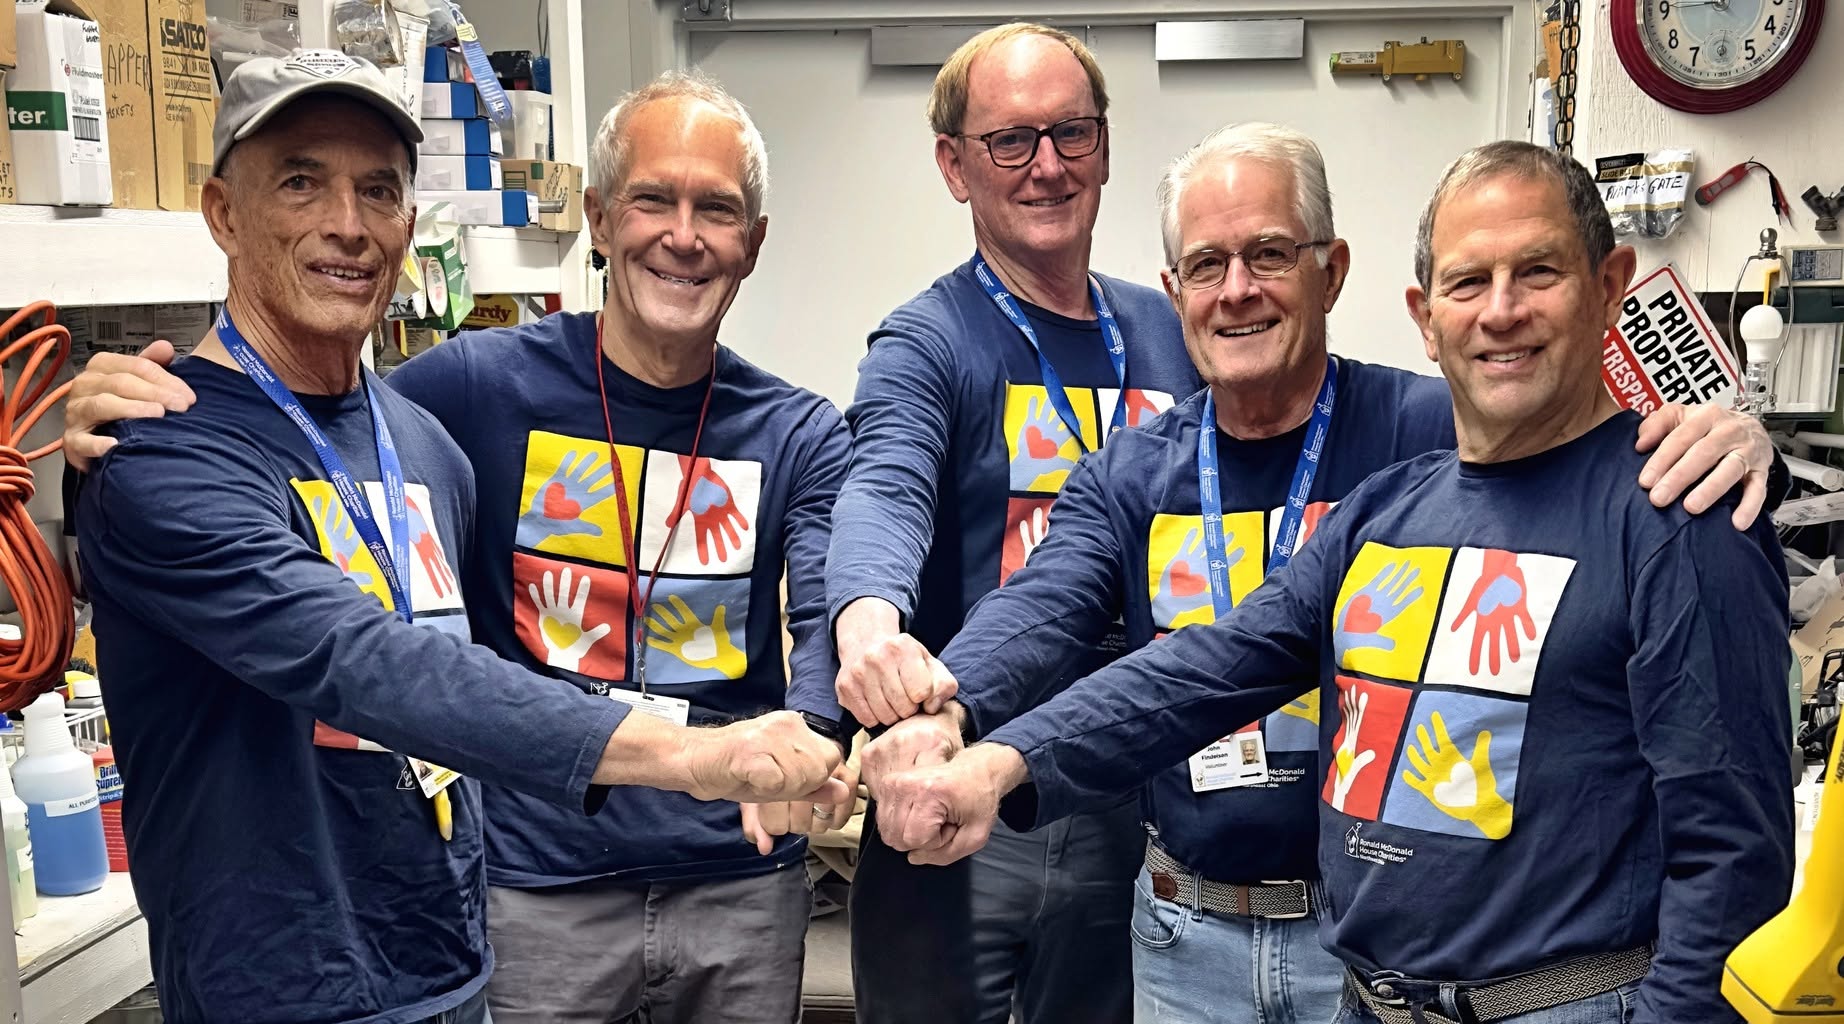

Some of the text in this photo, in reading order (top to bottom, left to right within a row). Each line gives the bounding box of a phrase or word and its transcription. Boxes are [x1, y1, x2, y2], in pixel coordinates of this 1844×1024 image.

[1659, 0, 1670, 20] 9
[164, 18, 206, 52] SATCO
[1764, 15, 1776, 35] 4
[1668, 29, 1679, 49] 8
[1689, 47, 1700, 66] 7
[1744, 39, 1756, 60] 5
[1648, 175, 1684, 195] GATE
[1647, 290, 1730, 401] PRIVATE
[1268, 768, 1305, 776] McDonald
